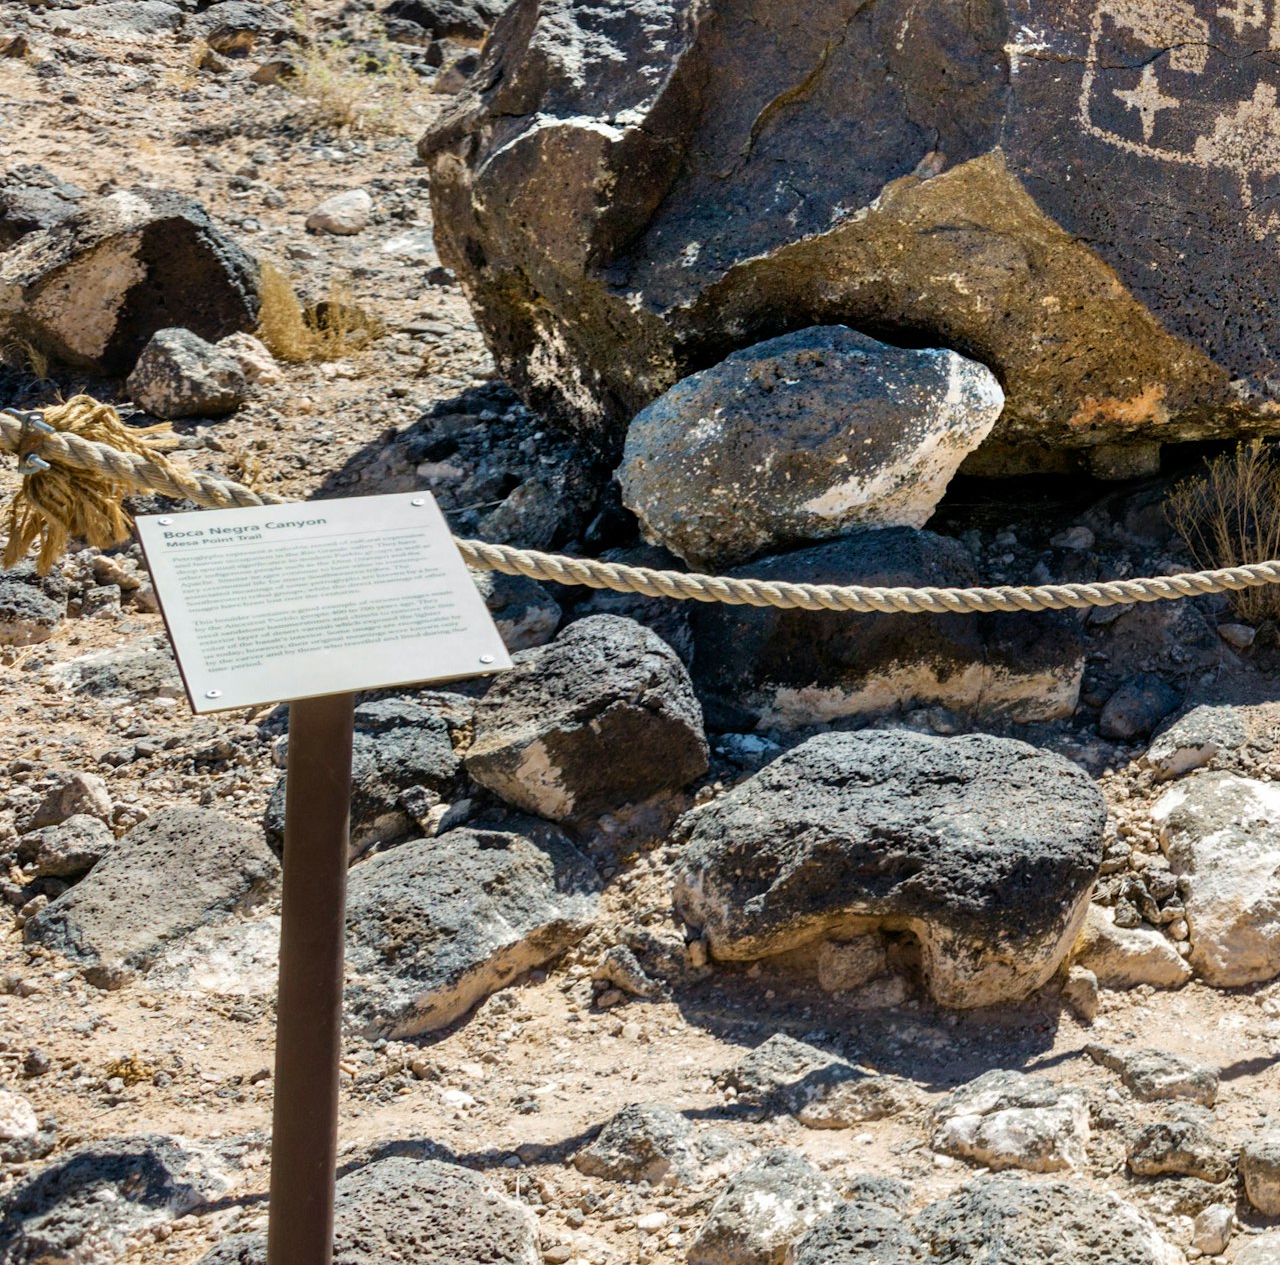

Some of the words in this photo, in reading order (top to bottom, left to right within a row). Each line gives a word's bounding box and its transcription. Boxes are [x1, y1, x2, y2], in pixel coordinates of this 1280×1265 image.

[164, 530, 204, 539] Boca
[209, 525, 260, 535] Negra
[265, 519, 328, 530] Canyon
